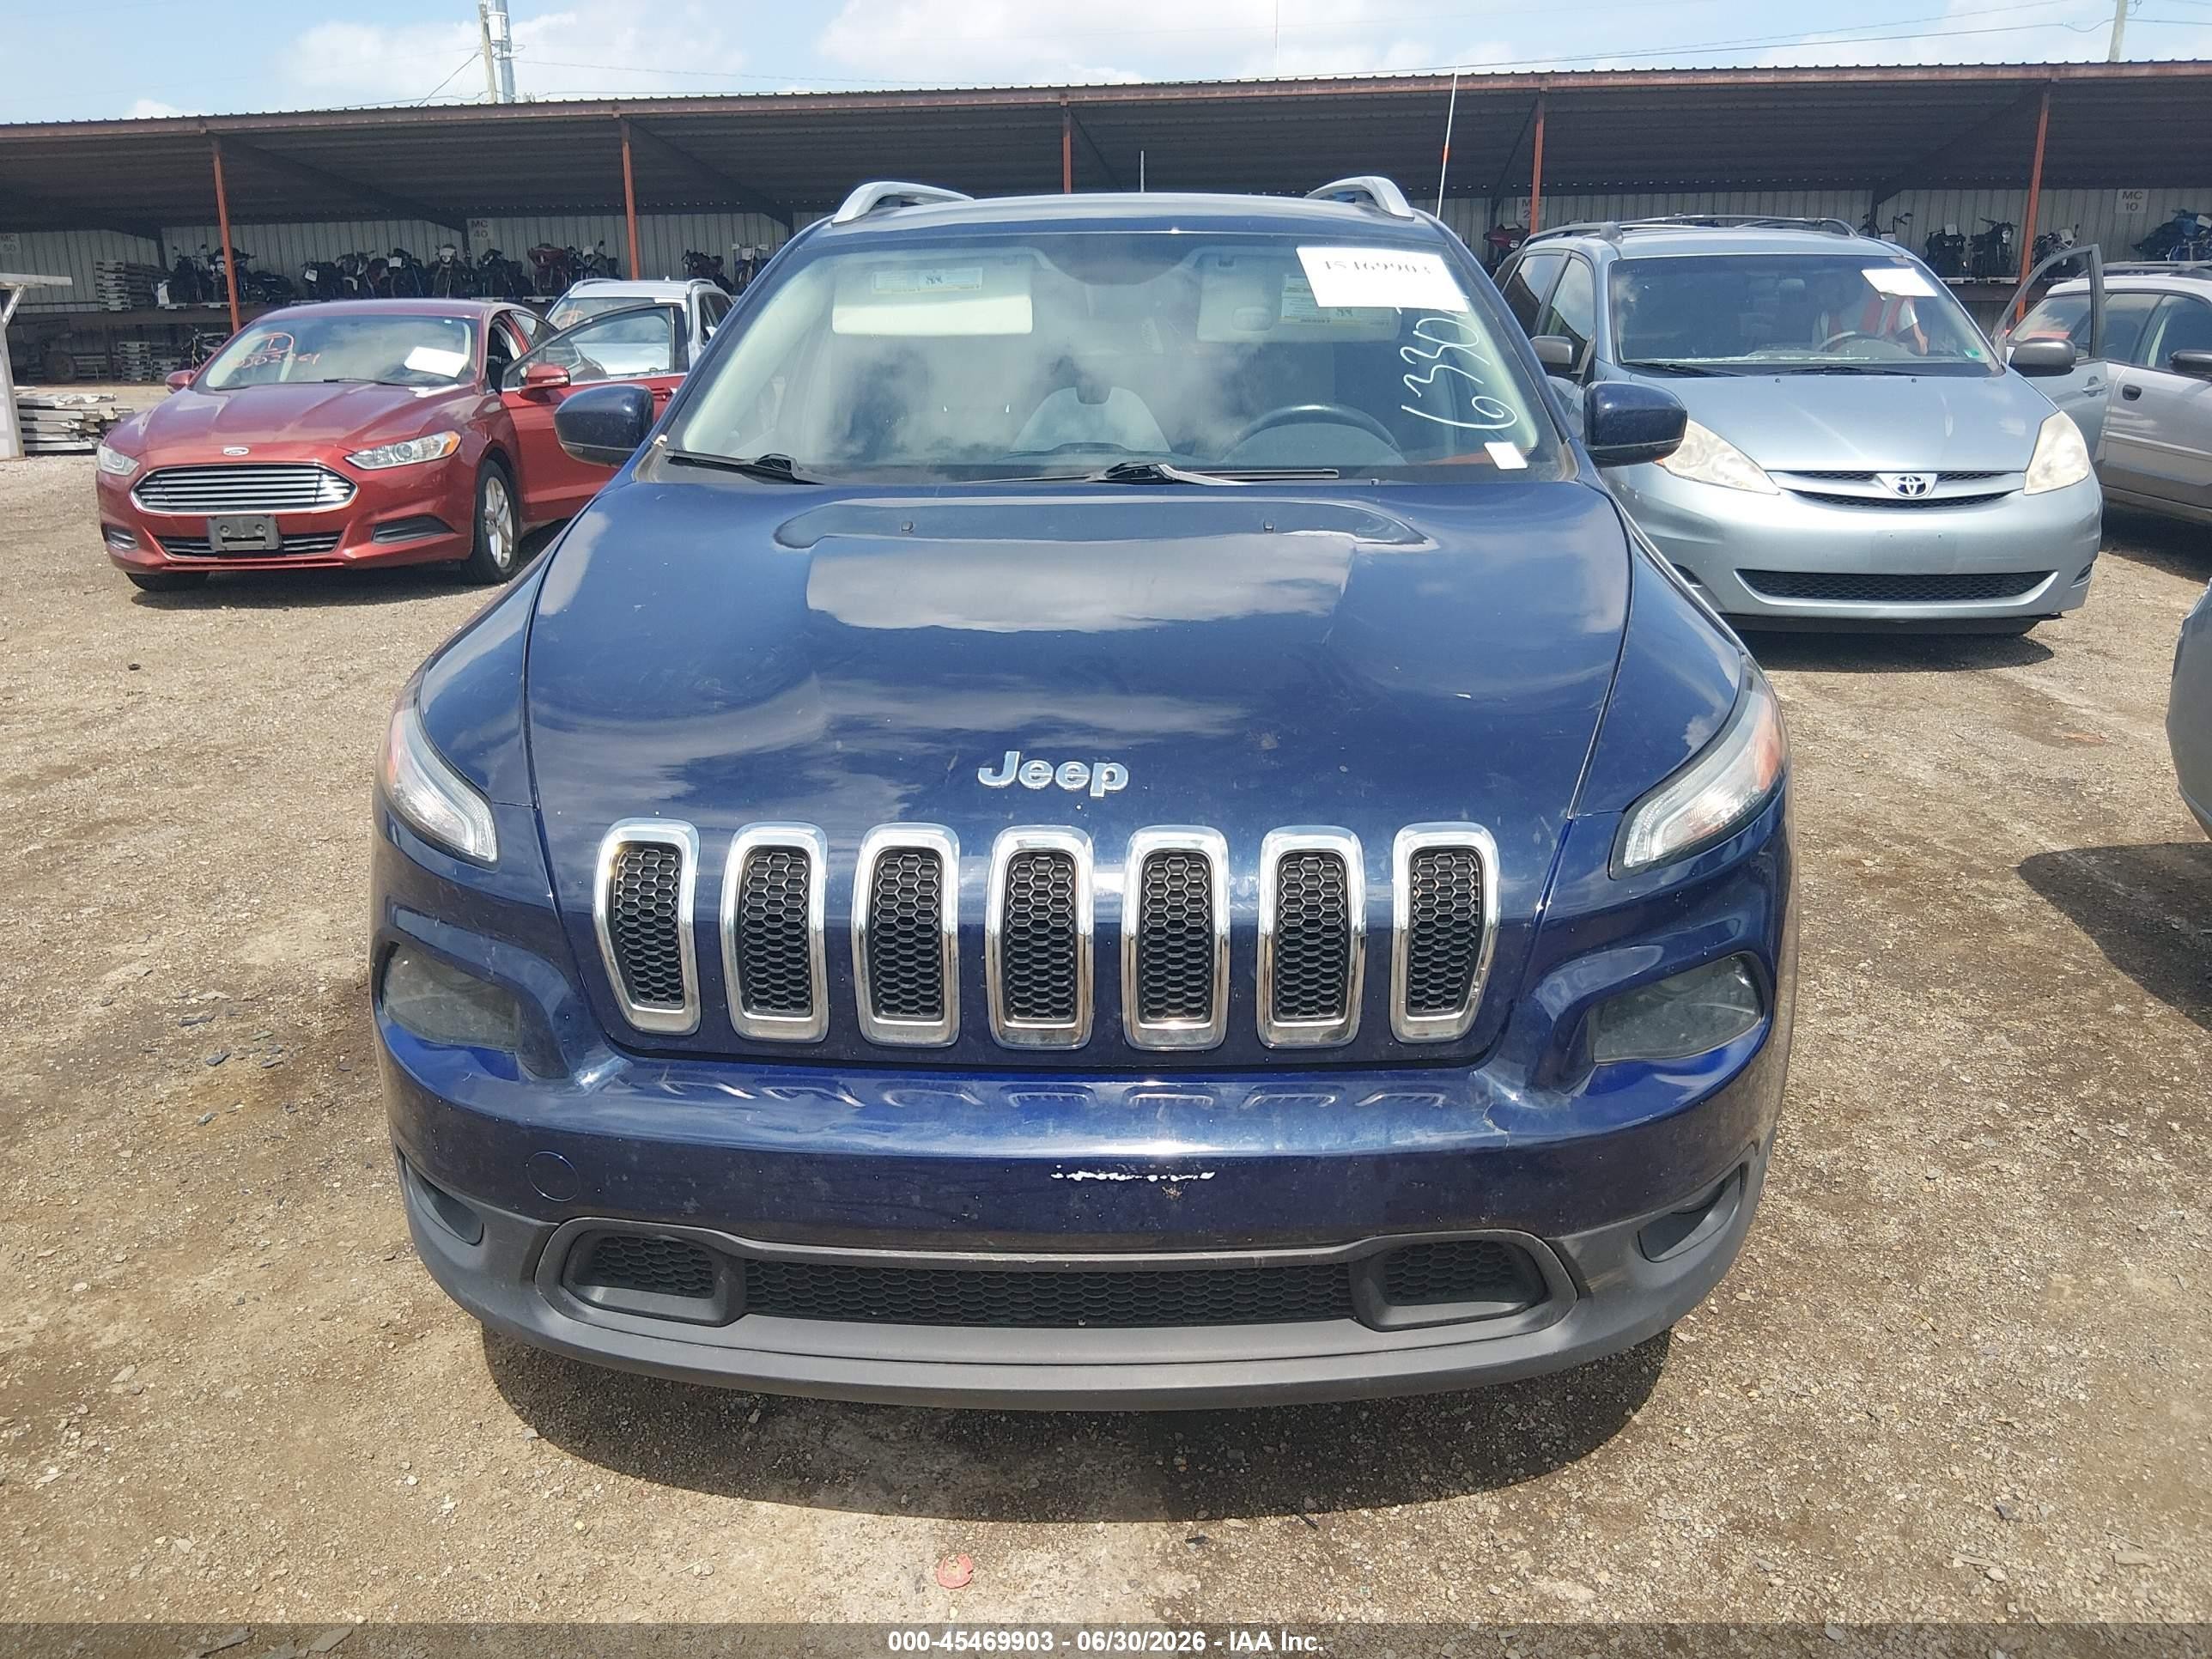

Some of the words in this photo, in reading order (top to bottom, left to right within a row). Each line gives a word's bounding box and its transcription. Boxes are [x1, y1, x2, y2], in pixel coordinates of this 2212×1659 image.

[2123, 191, 2143, 200] MC
[2125, 203, 2138, 211] 10
[471, 220, 489, 228] MC
[0, 234, 15, 242] MC
[978, 750, 1129, 798] Jeep
